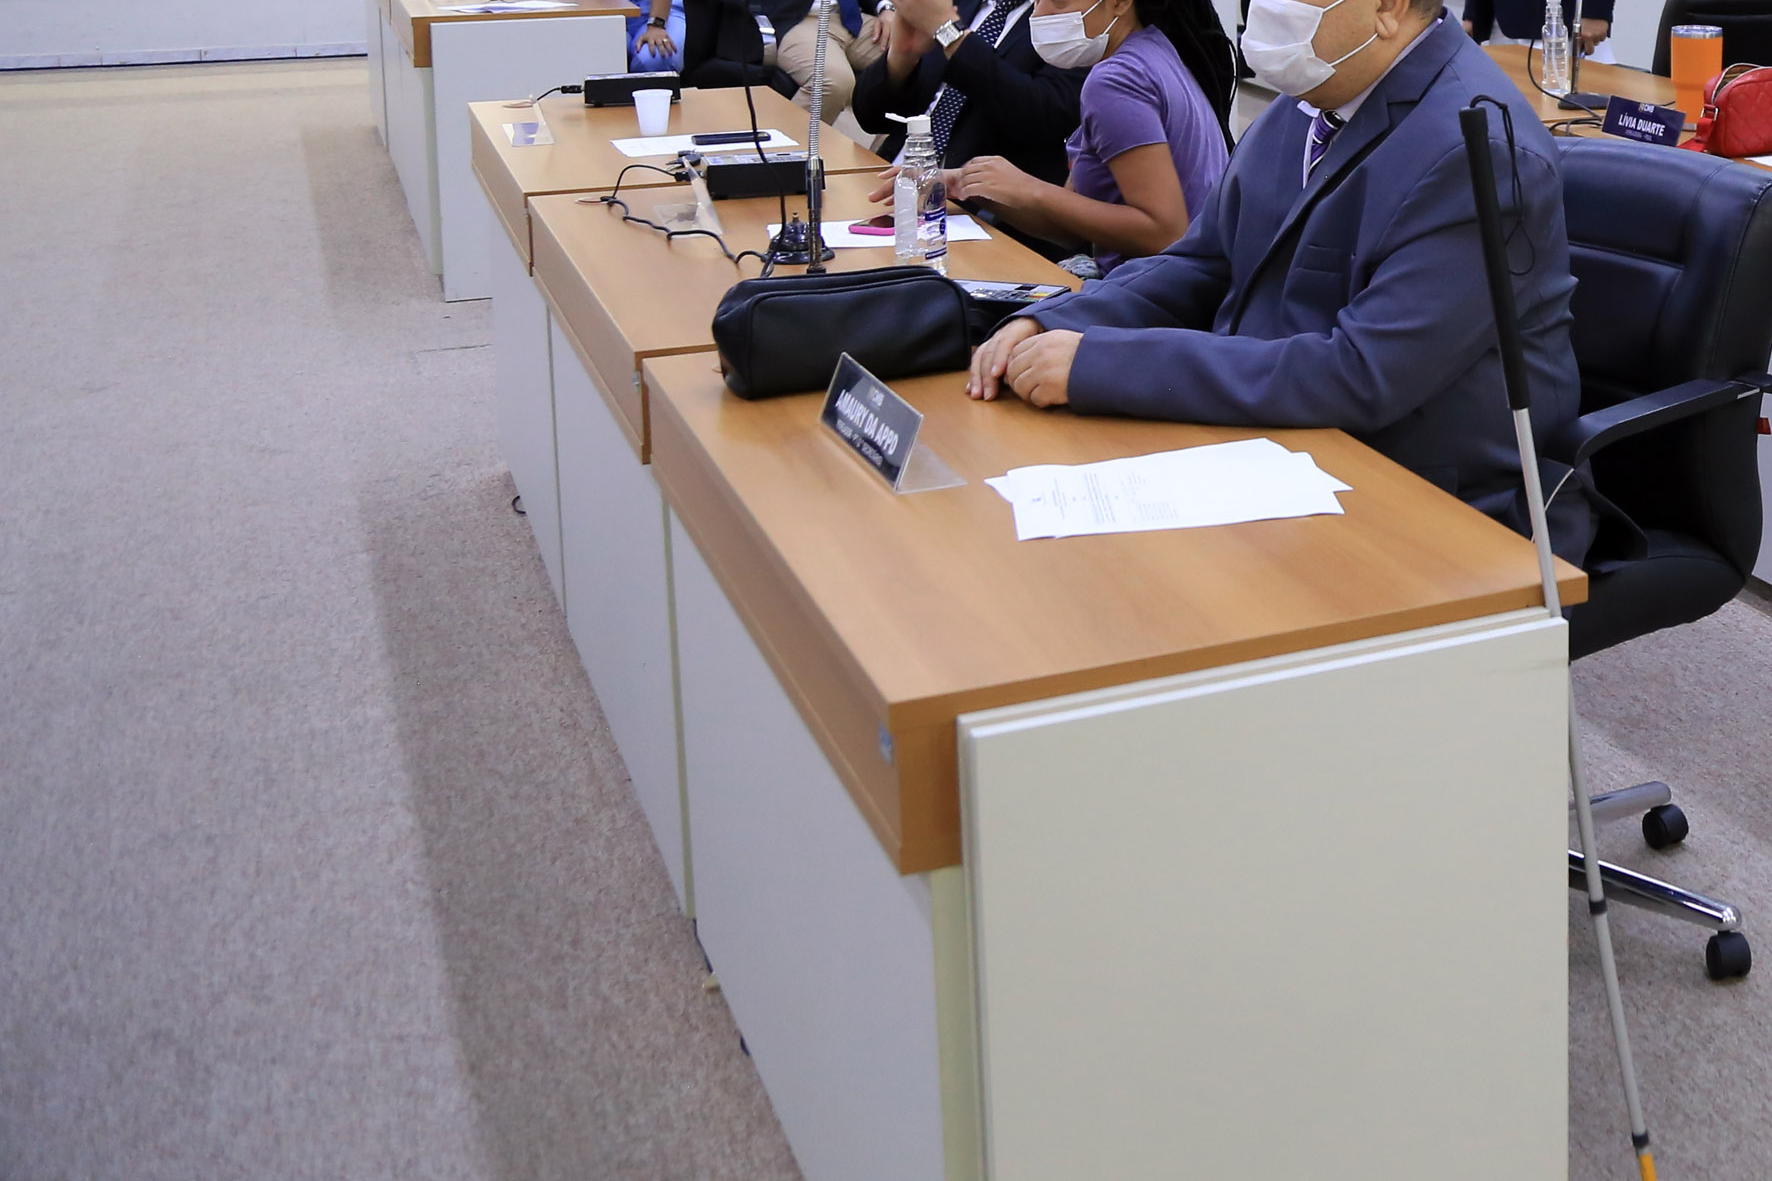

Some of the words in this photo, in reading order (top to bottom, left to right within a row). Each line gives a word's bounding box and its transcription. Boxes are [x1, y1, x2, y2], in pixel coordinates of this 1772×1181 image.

[1618, 112, 1636, 130] LÍVIA
[1636, 119, 1665, 136] DUARTE
[835, 389, 869, 428] AMAURY
[863, 412, 879, 440] DA
[874, 422, 899, 455] APPD
